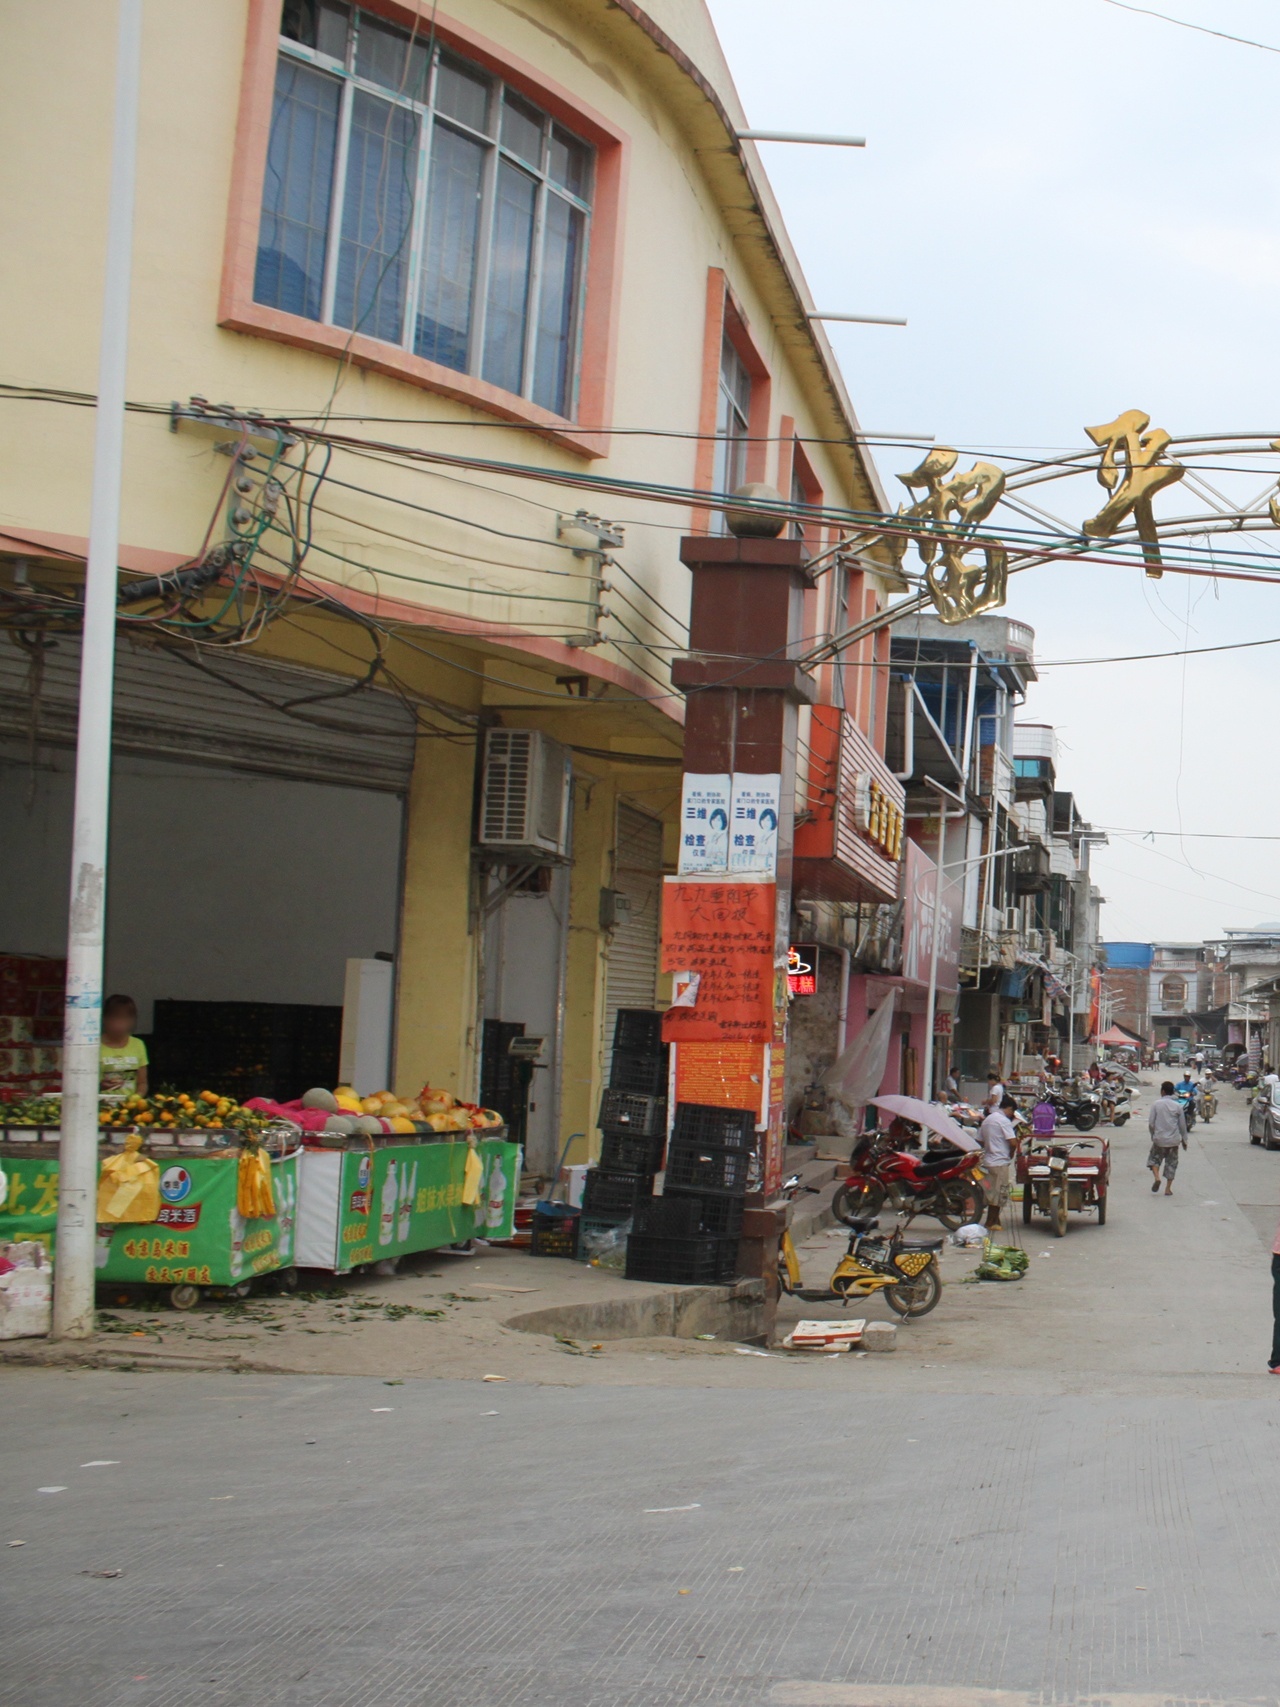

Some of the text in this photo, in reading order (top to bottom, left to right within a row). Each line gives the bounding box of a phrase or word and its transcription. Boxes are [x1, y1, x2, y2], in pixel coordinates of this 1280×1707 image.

[685, 807, 707, 820] 三维
[735, 807, 757, 820] 三维
[684, 834, 706, 847] 检查
[734, 834, 755, 847] 检查
[674, 886, 758, 905] 九九重阳节
